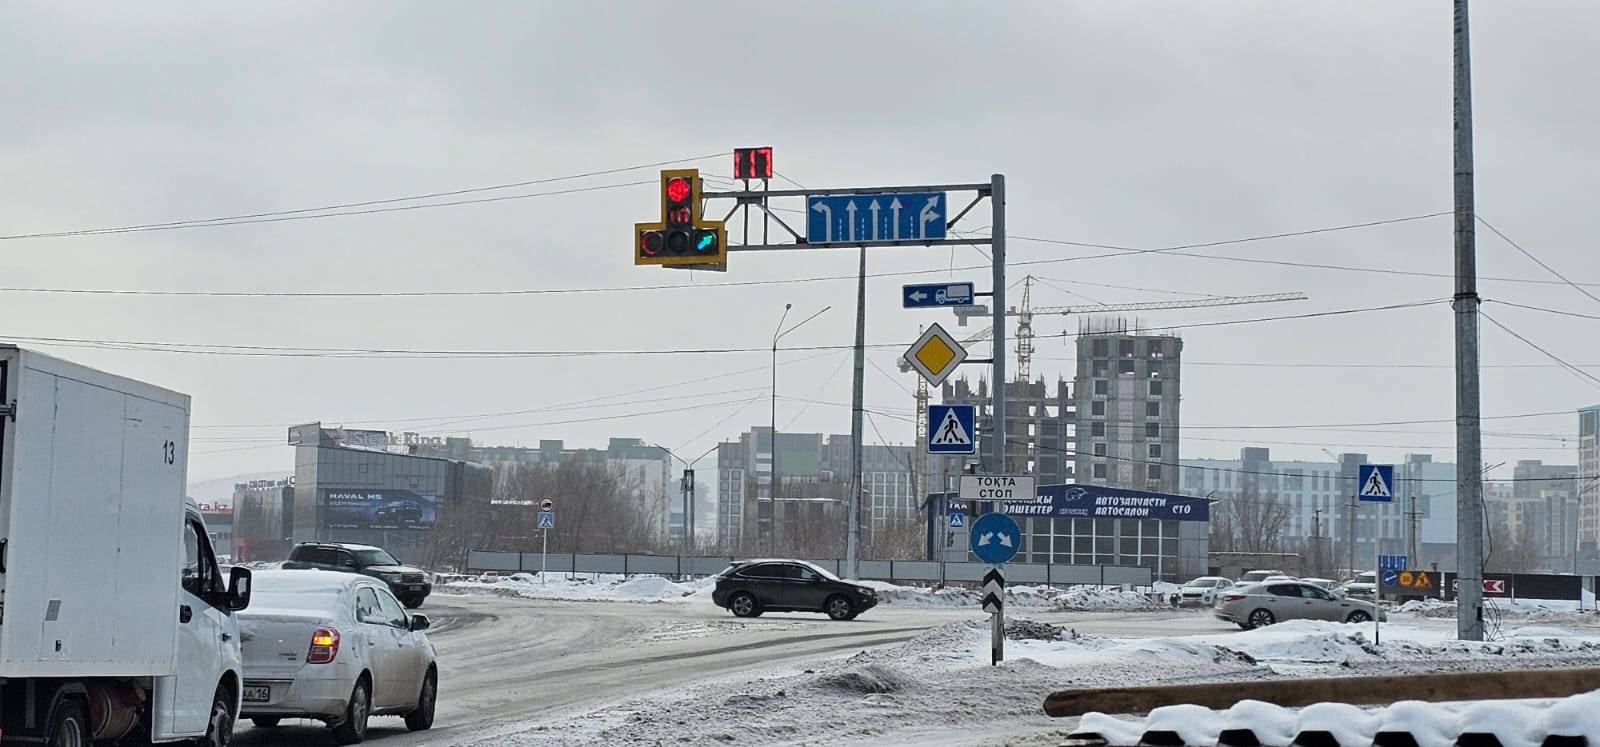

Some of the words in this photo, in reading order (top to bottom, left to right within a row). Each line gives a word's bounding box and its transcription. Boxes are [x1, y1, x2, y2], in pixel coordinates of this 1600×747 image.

[163, 440, 174, 465] 13
[977, 477, 1016, 487] ТОҚТА
[979, 489, 1012, 498] СТОП
[1095, 496, 1166, 507] АВТОЗАПЧАСТИ
[1095, 506, 1149, 517] АВТОСАЛОН
[1172, 504, 1191, 514] СТО
[256, 688, 267, 698] 16
